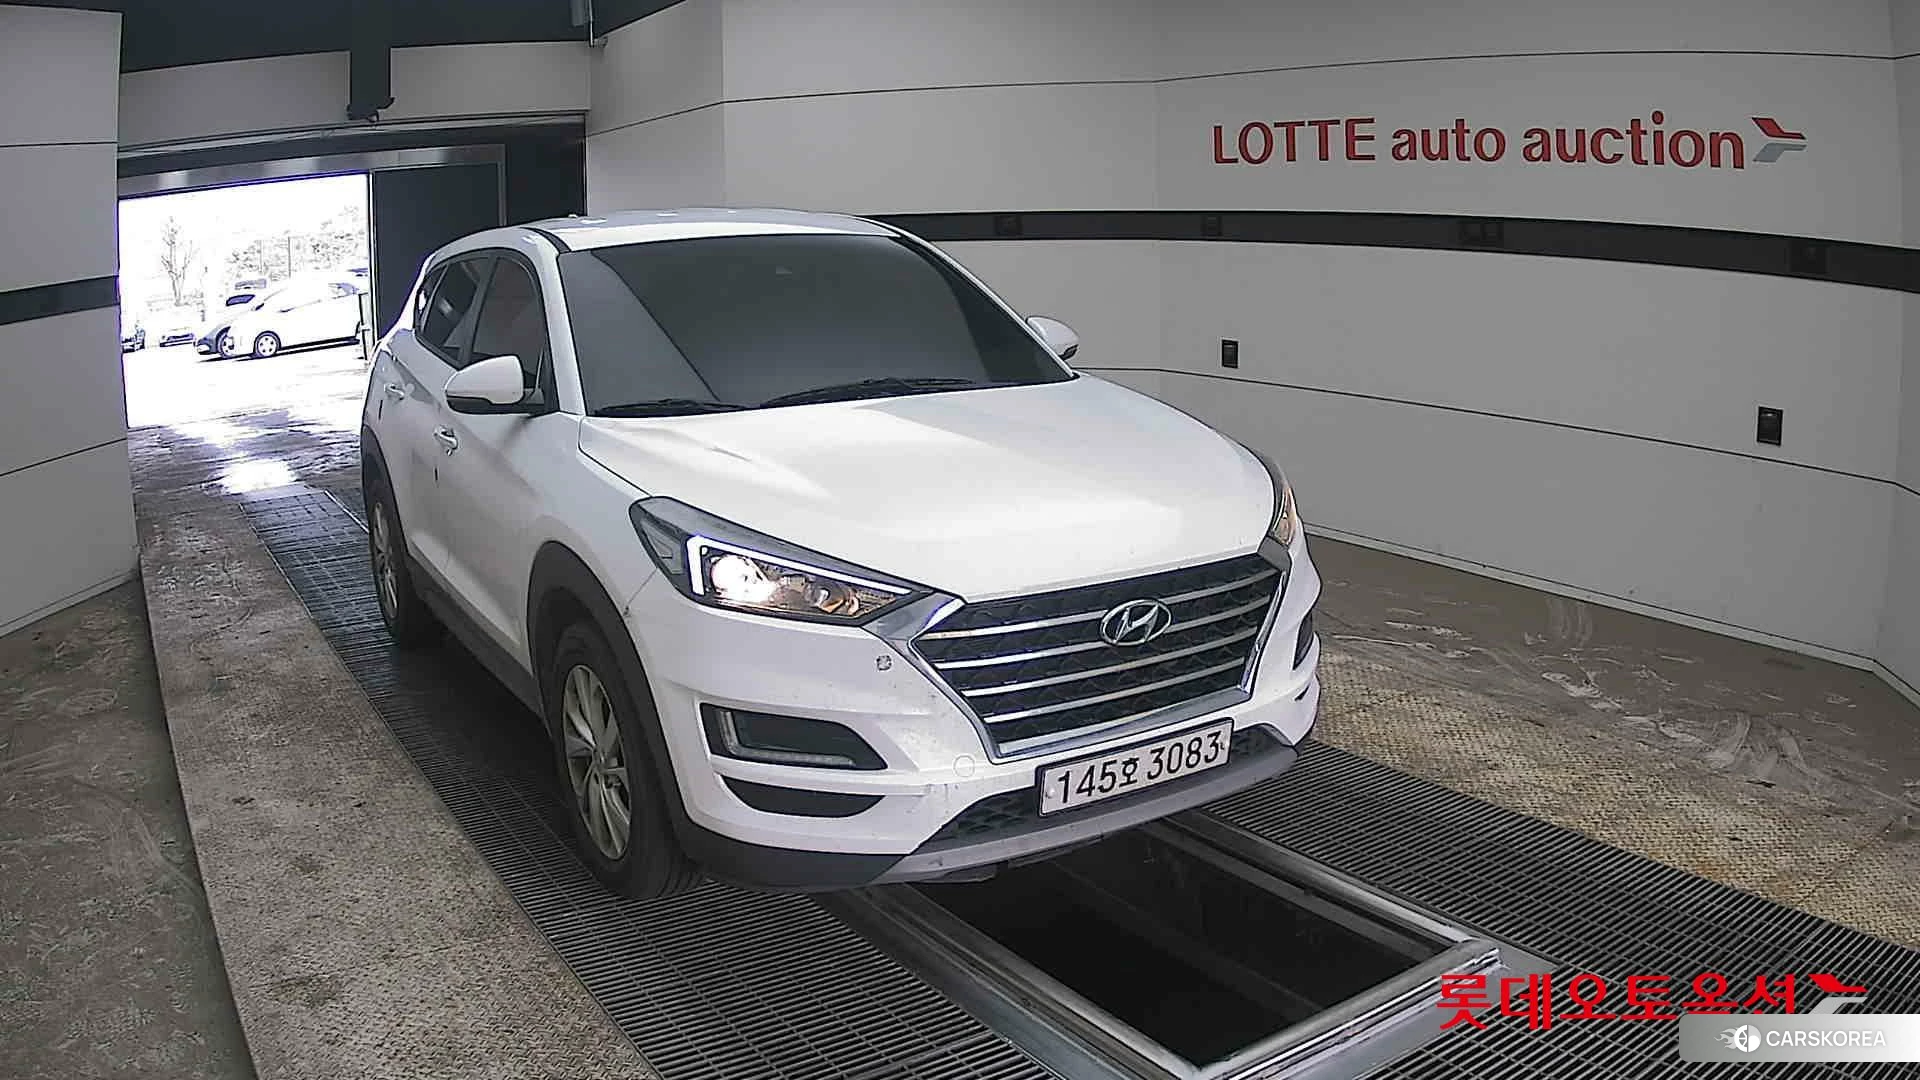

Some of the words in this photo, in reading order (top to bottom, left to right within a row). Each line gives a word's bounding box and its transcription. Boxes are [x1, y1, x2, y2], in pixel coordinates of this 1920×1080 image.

[1212, 116, 1377, 165] LOTTE
[1391, 118, 1507, 163] auto
[1522, 111, 1745, 169] auction
[1057, 756, 1140, 804] 145호
[1146, 730, 1222, 781] 3083
